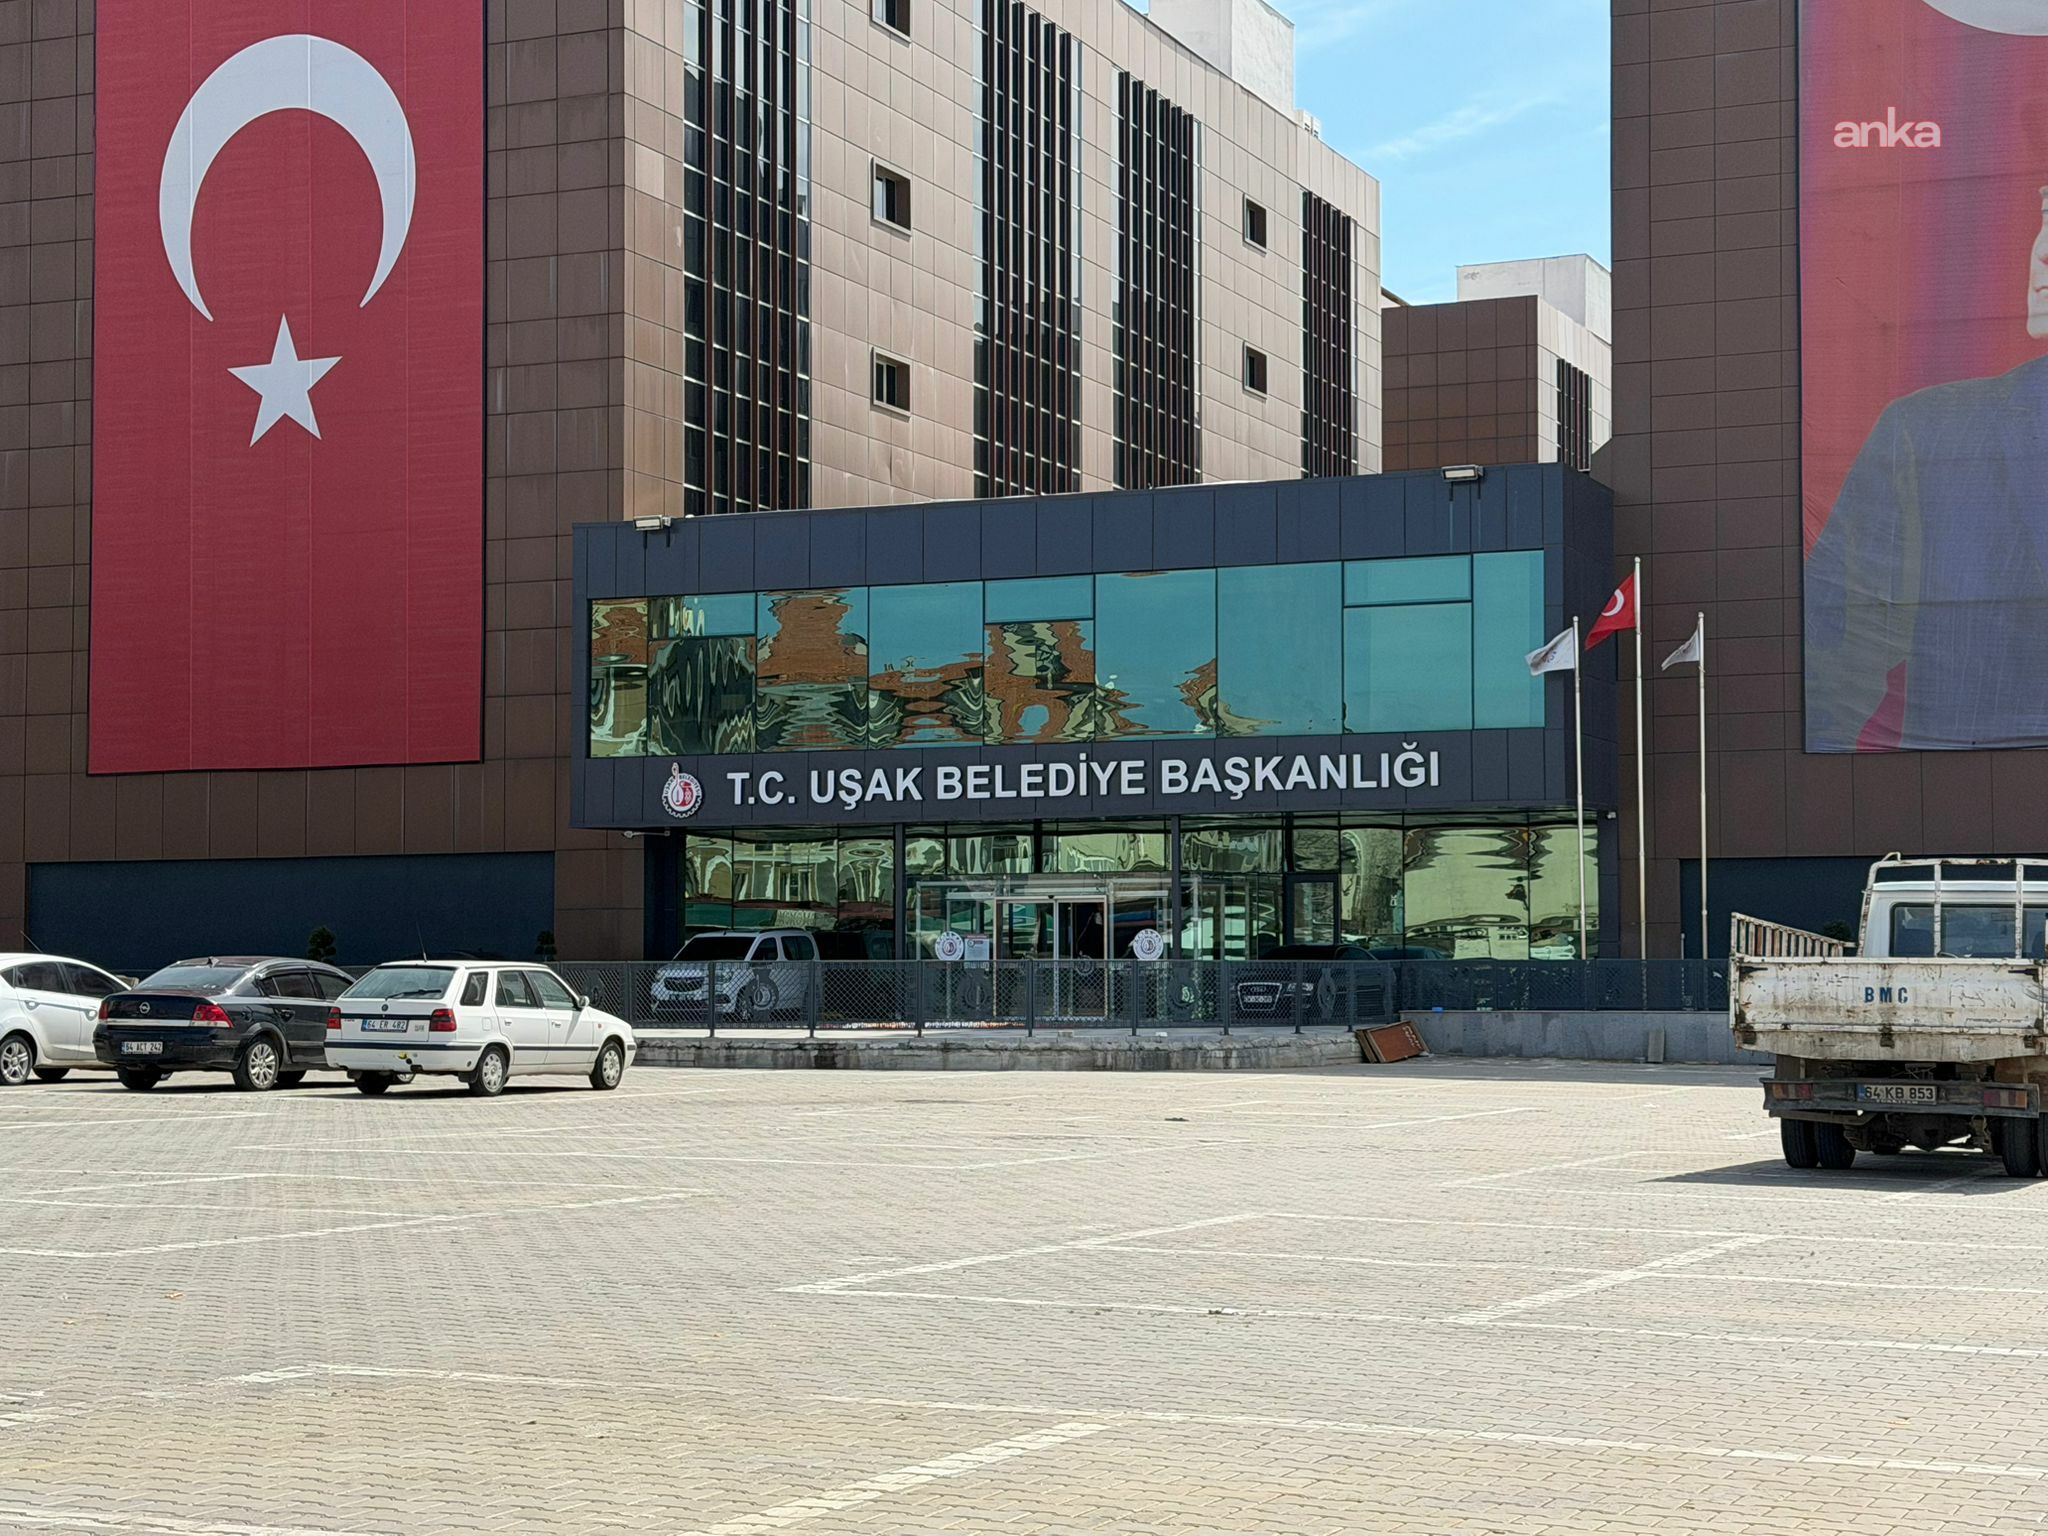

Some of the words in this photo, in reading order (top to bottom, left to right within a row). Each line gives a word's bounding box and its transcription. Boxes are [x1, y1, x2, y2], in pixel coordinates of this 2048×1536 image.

[726, 771, 795, 805] T.C.
[810, 768, 923, 811] UŞAK
[937, 752, 1145, 800] BELEDİYE
[1161, 741, 1439, 800] BAŞKANLIĞI
[1864, 986, 1909, 1003] BMC
[1865, 1086, 1881, 1099] 64
[1885, 1087, 1905, 1099] KB
[1909, 1088, 1934, 1100] 853
